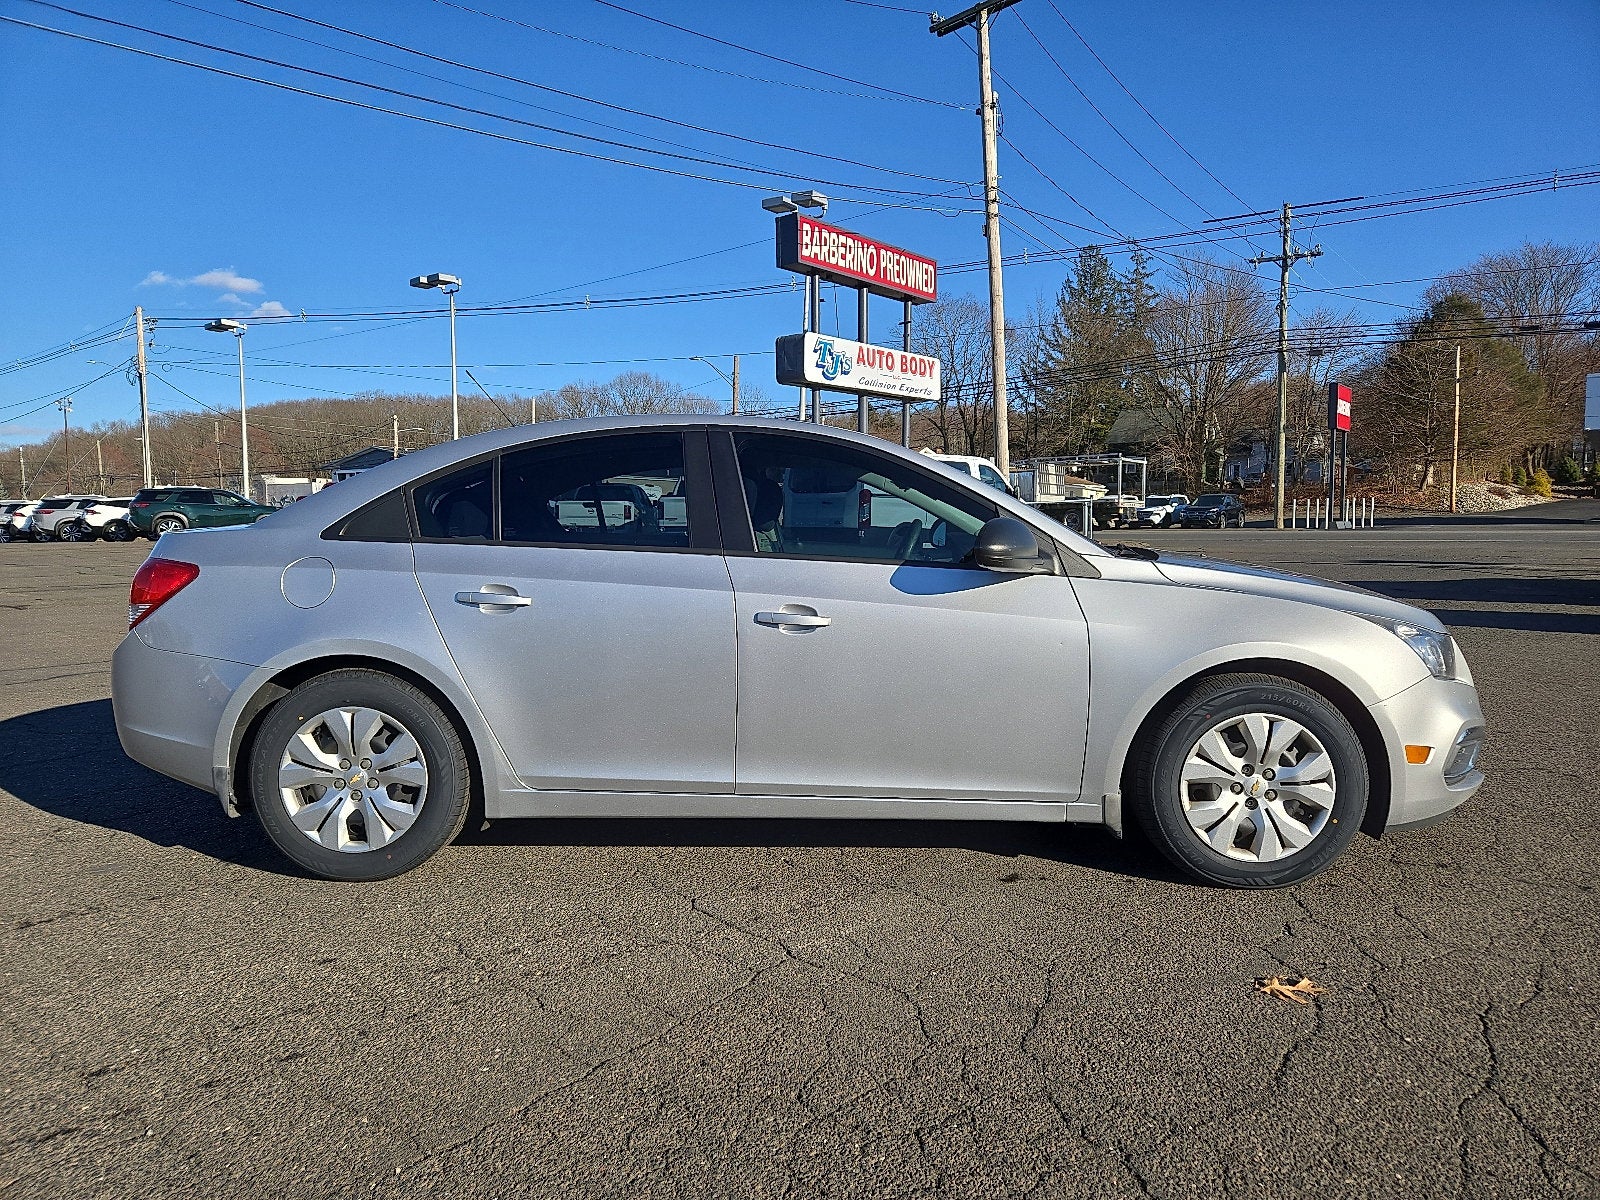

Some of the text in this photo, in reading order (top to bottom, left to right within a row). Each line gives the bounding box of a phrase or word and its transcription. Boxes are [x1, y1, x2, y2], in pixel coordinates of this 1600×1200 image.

[801, 222, 935, 294] BARBERINO PREOWNED
[856, 345, 936, 379] AUTO BODY
[858, 376, 897, 391] Collision
[898, 383, 933, 397] Experts
